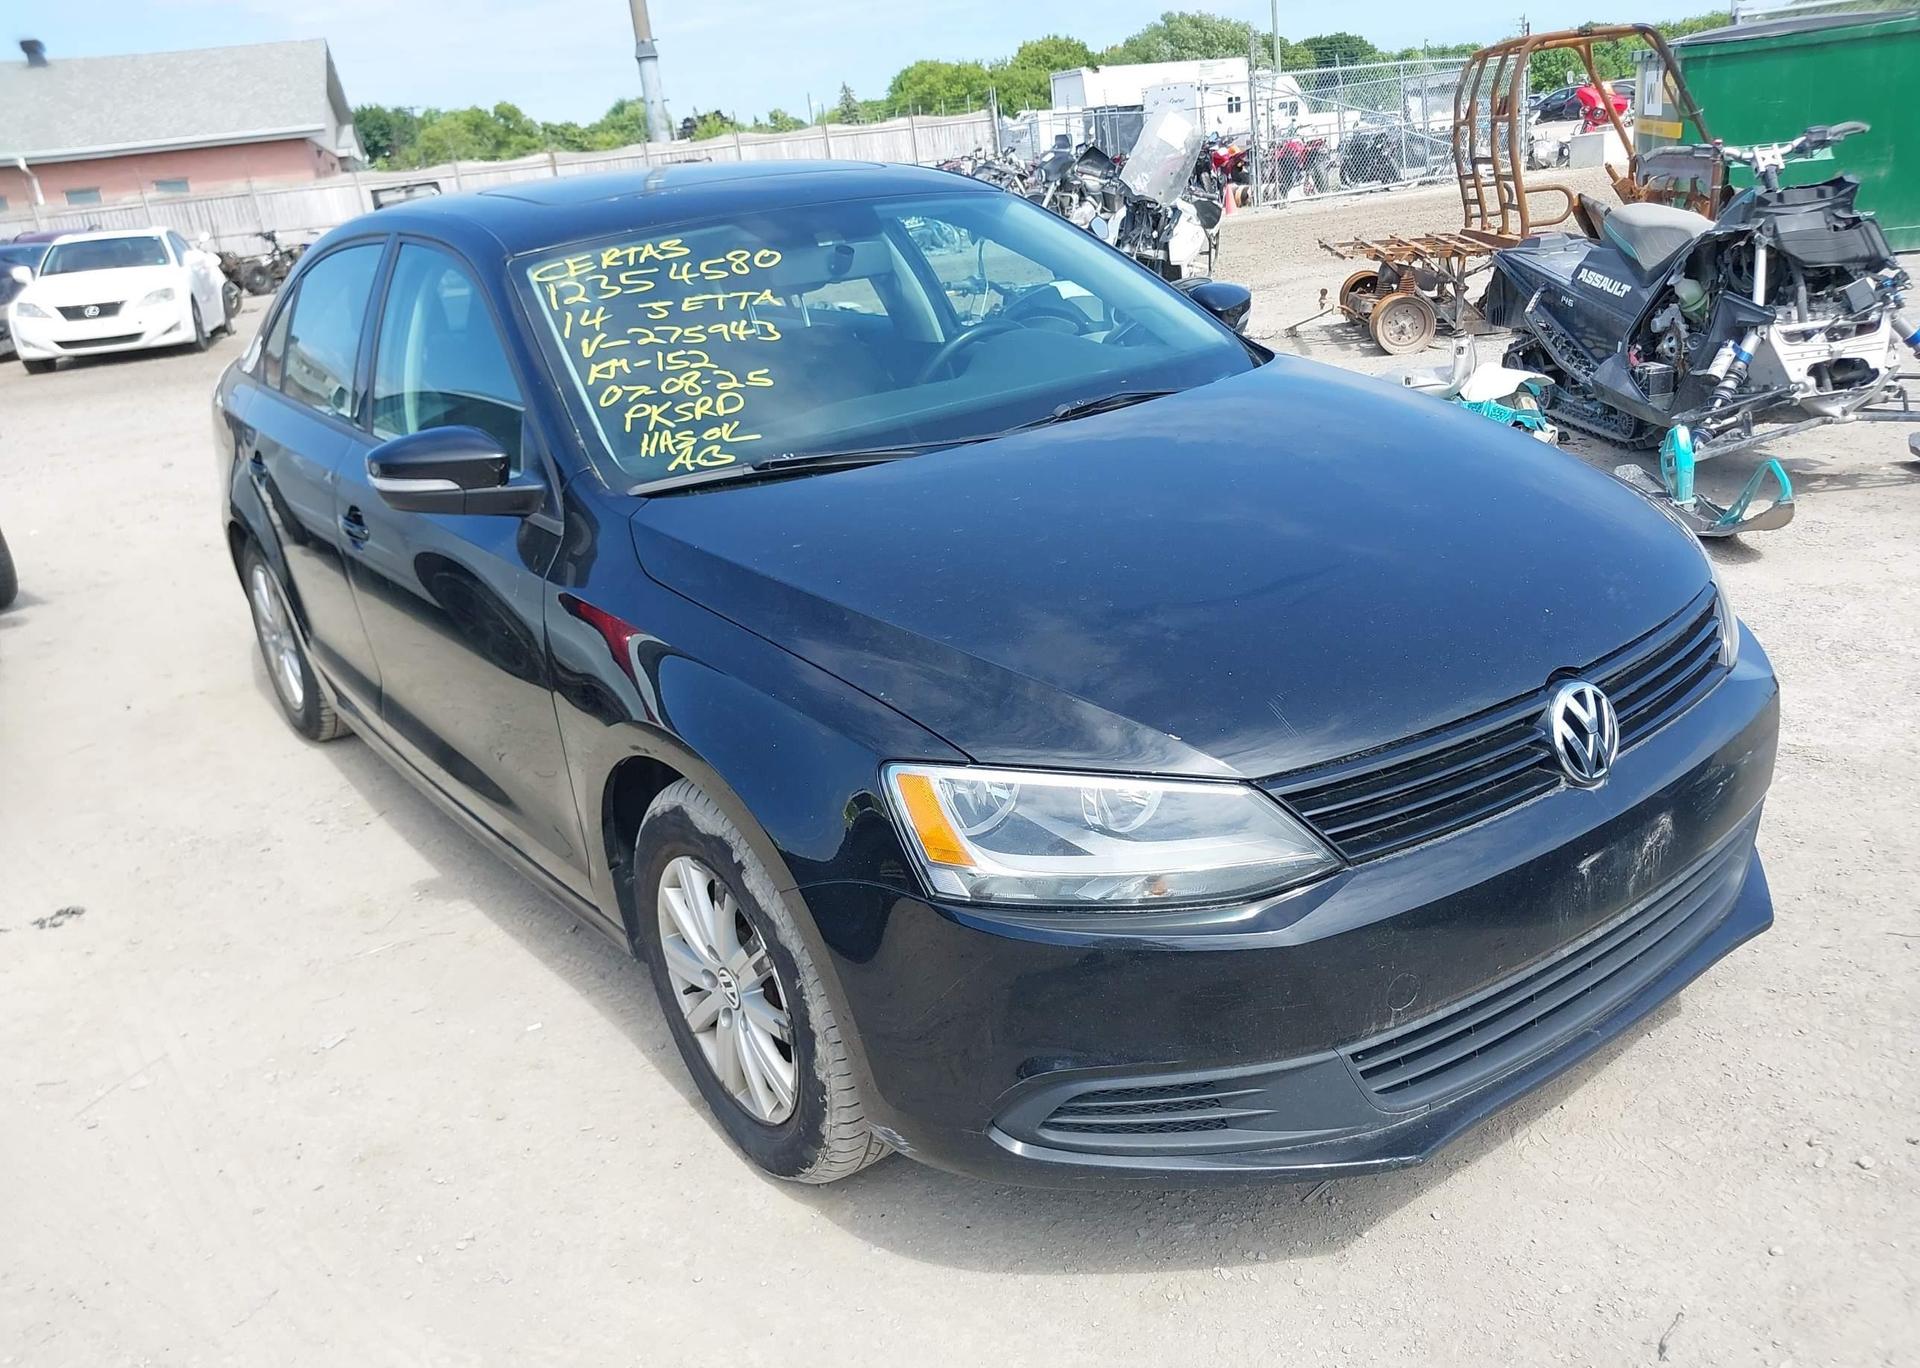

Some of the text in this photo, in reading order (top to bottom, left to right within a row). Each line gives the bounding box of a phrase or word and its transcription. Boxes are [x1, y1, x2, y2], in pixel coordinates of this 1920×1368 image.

[532, 238, 691, 283] CERTAS
[1577, 267, 1632, 298] ASSAULT
[1561, 295, 1574, 308] 146
[563, 306, 613, 338] 14
[624, 391, 745, 432] PKSRD
